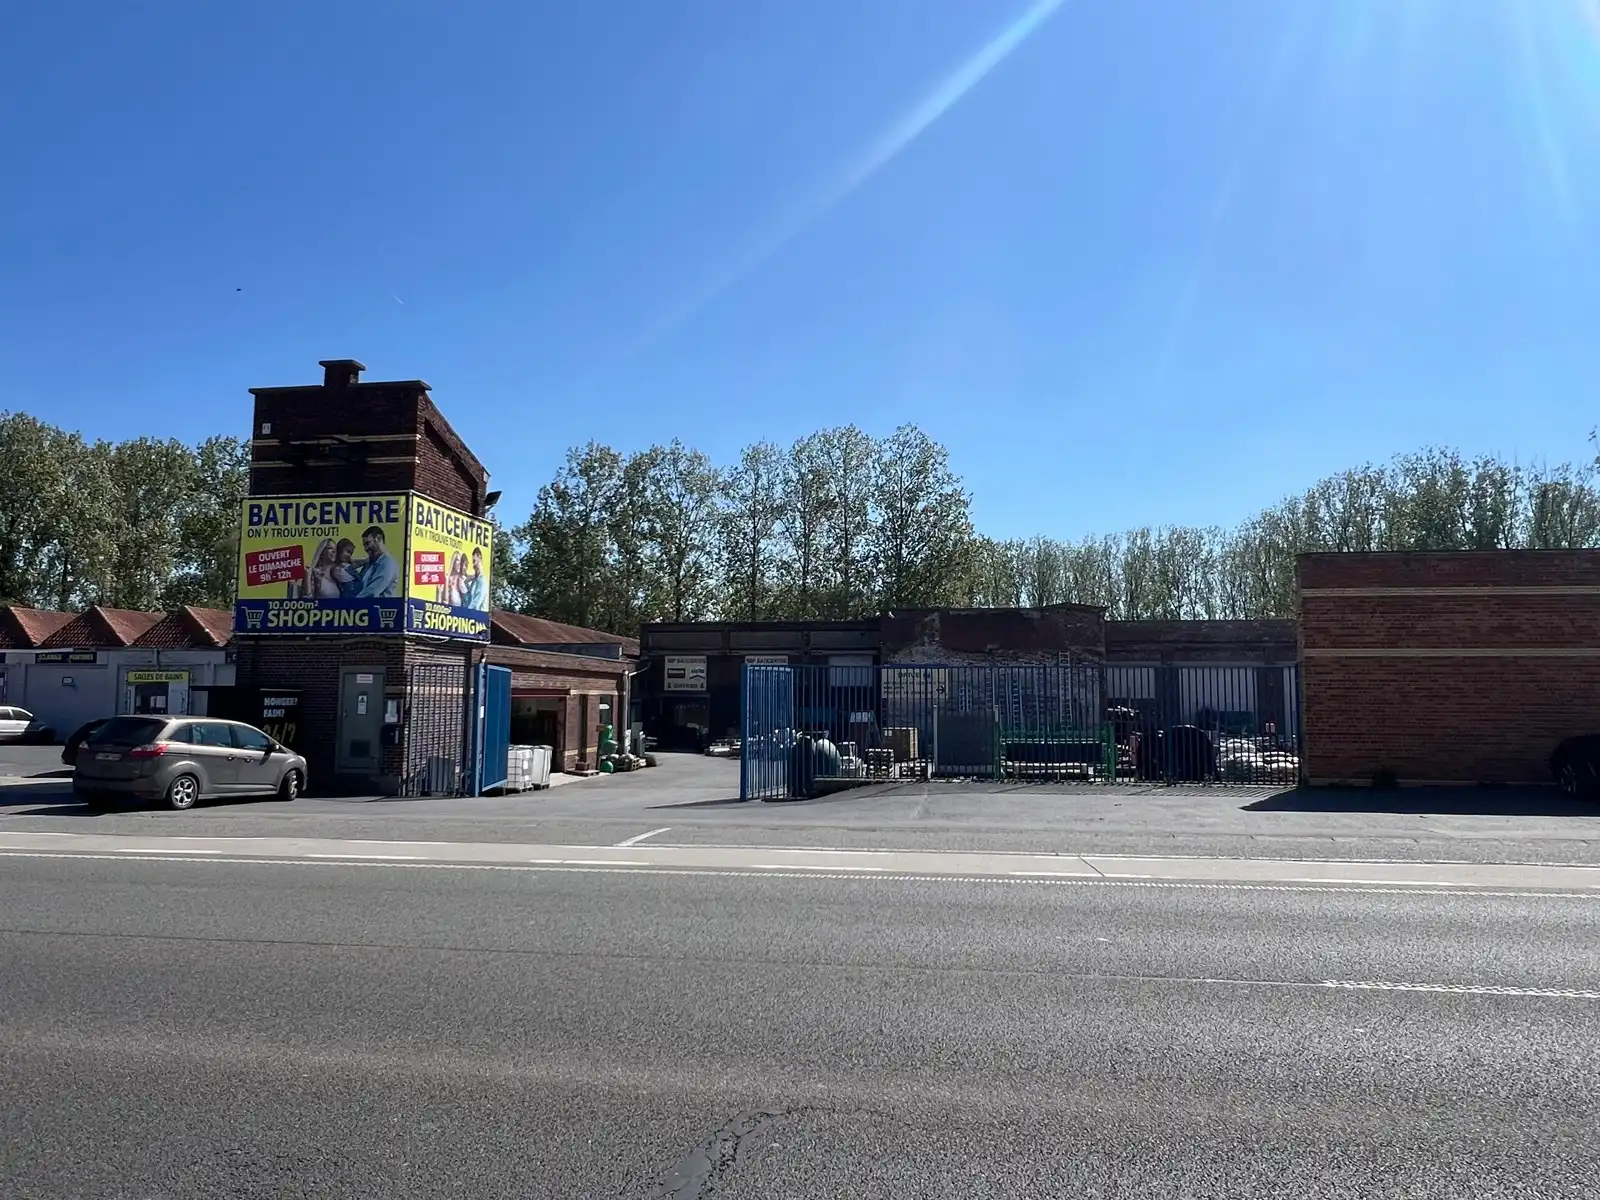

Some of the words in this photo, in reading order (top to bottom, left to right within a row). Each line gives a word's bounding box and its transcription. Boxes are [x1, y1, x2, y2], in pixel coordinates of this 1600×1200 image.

[248, 500, 400, 526] BATICENTRE
[247, 528, 261, 538] ON
[262, 528, 270, 538] Y
[271, 527, 309, 538] TROUVE
[311, 526, 340, 537] TOUT!
[415, 527, 423, 538] ON
[416, 501, 489, 548] BATICENTRE
[258, 550, 290, 562] OUVERT
[248, 565, 257, 574] LE
[259, 558, 301, 572] DIMANCHE
[260, 573, 271, 582] 9h
[277, 570, 292, 579] 12h
[267, 609, 369, 628] SHOPPING
[424, 612, 475, 635] SHOPPING
